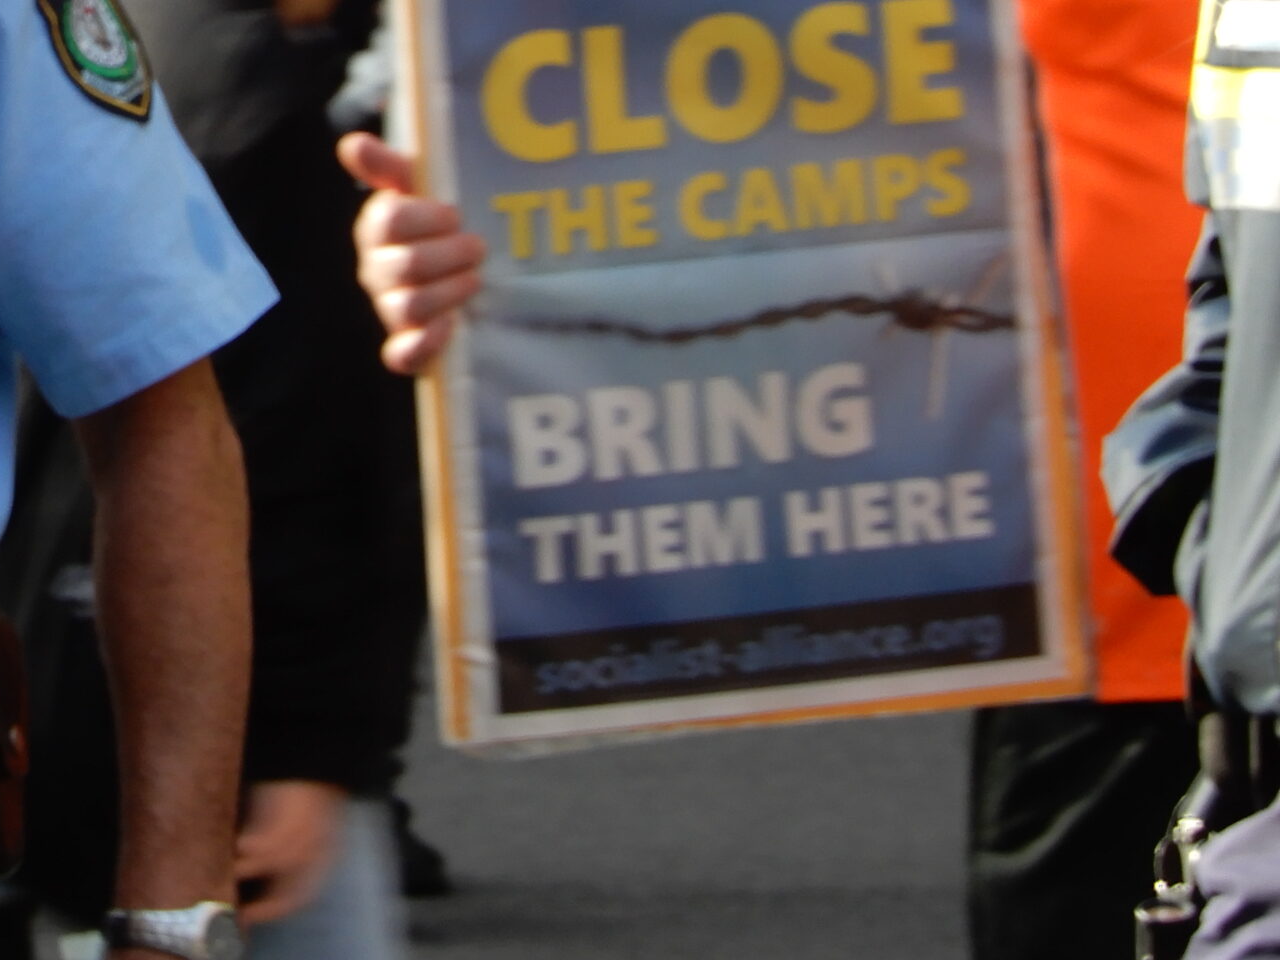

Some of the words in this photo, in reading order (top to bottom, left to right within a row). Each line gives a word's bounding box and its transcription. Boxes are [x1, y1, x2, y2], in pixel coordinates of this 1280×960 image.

[492, 180, 658, 260] THE
[678, 149, 972, 240] CAMPS
[508, 362, 876, 489] BRING
[519, 496, 764, 584] THEM
[784, 471, 996, 557] HERE
[537, 613, 1000, 695] socialist-alliance.org
